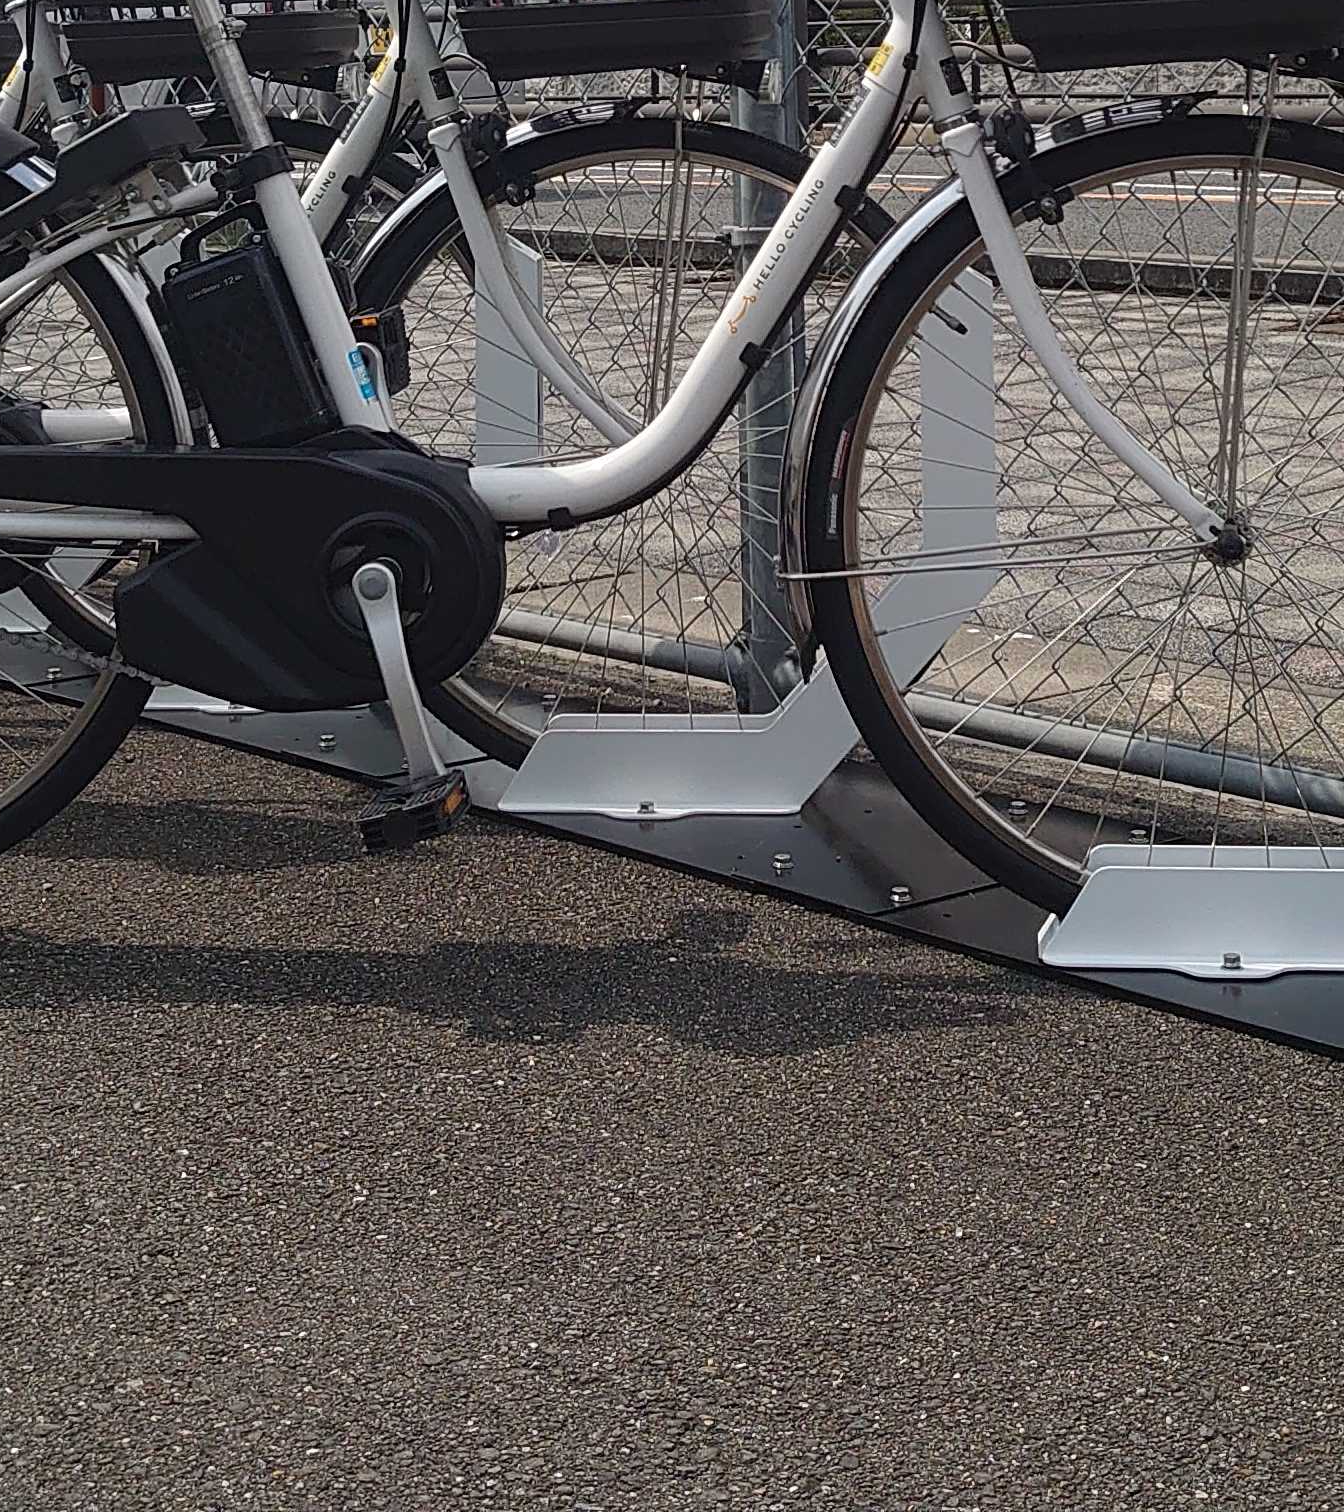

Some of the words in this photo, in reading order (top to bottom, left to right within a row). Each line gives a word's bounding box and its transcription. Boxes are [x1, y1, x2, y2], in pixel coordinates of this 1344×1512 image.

[306, 171, 337, 218] YCLING
[752, 243, 786, 291] HELLO
[784, 179, 825, 239] CYCLING
